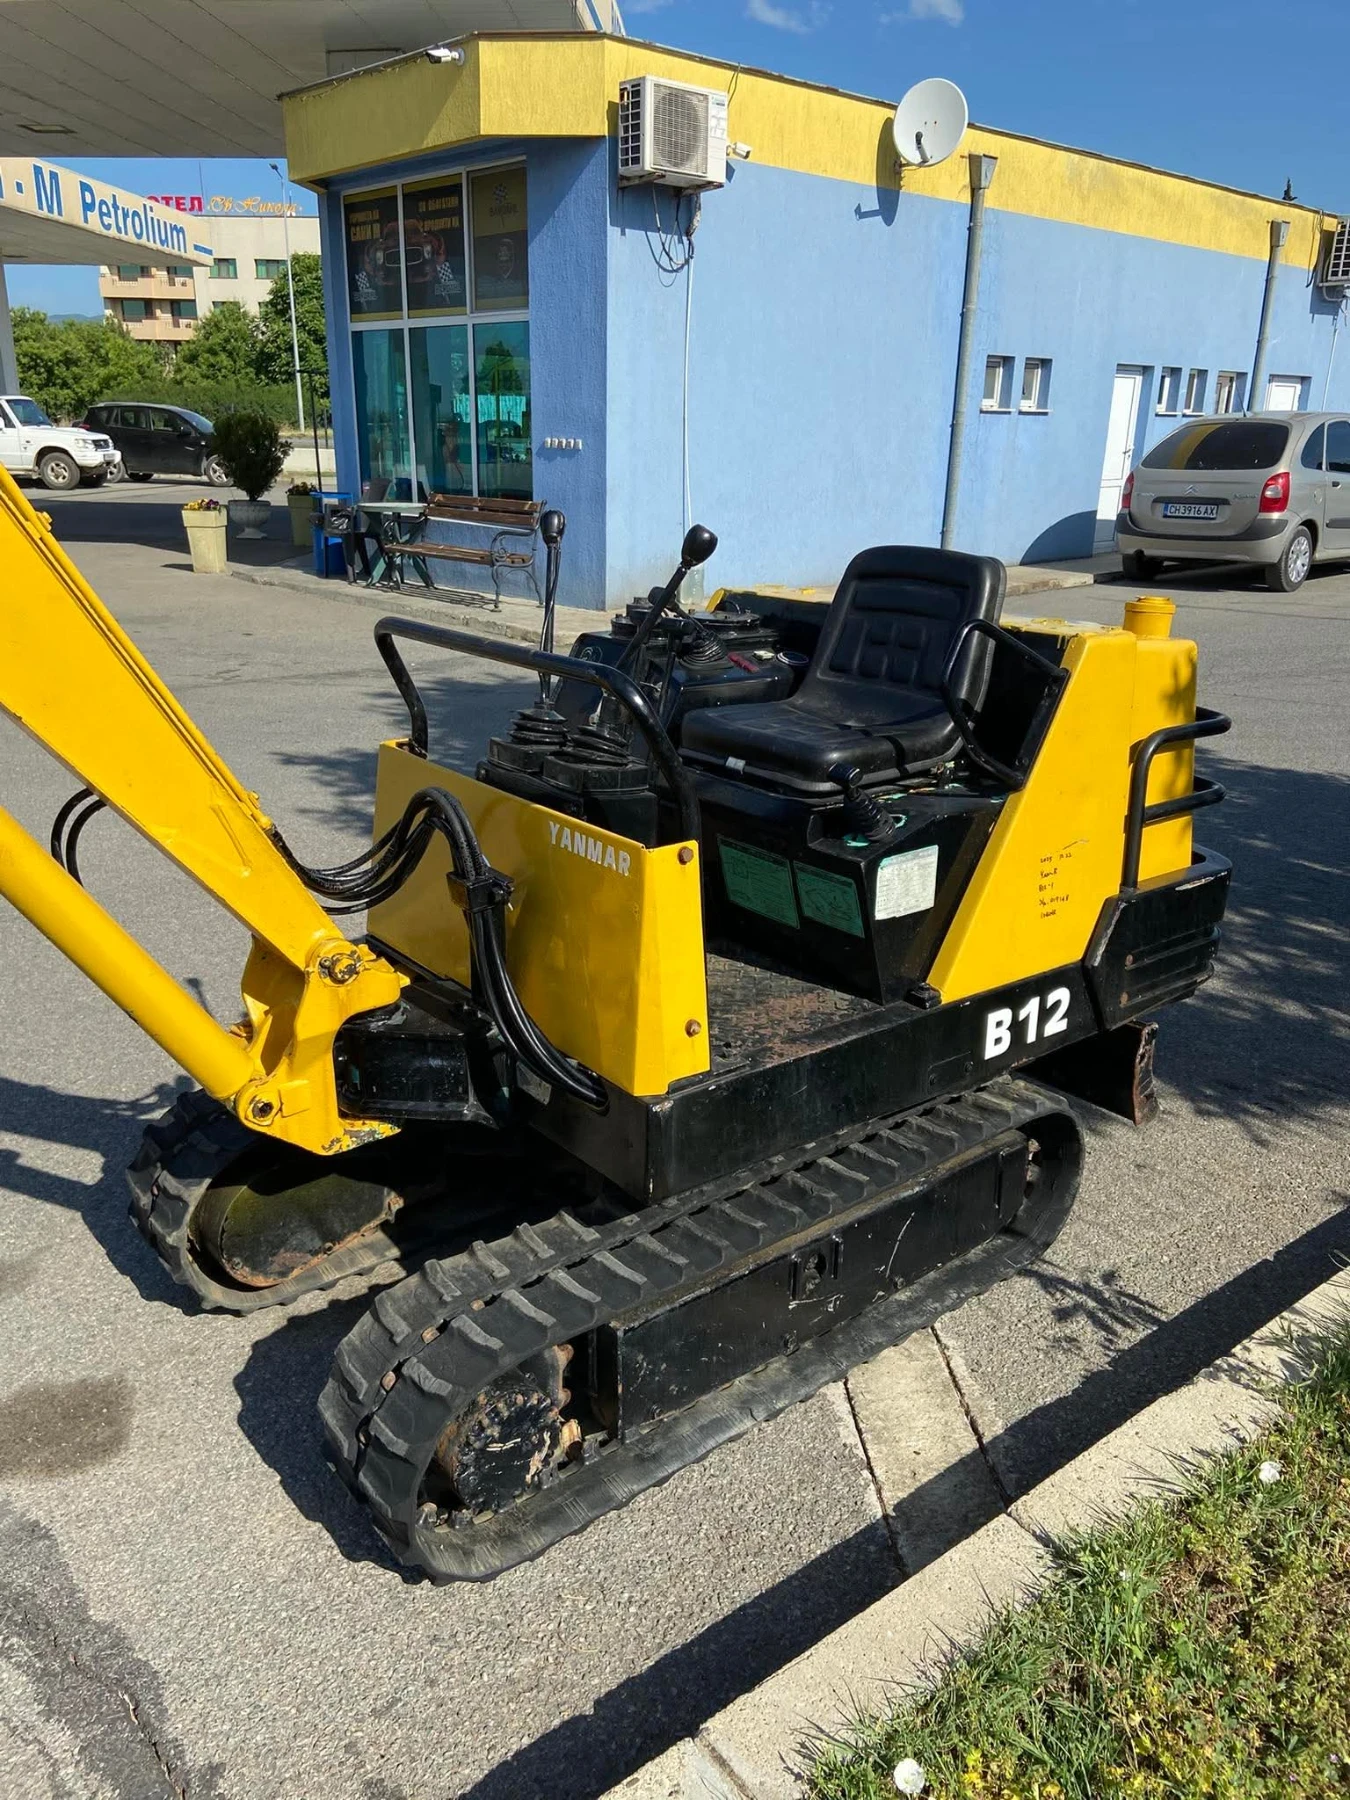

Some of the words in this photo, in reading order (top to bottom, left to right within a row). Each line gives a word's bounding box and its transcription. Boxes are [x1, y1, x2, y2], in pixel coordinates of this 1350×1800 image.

[33, 163, 63, 217] M
[79, 180, 187, 253] Petrolium
[1181, 506, 1202, 515] 3916
[549, 821, 631, 876] YANMAR
[984, 987, 1071, 1060] B12
